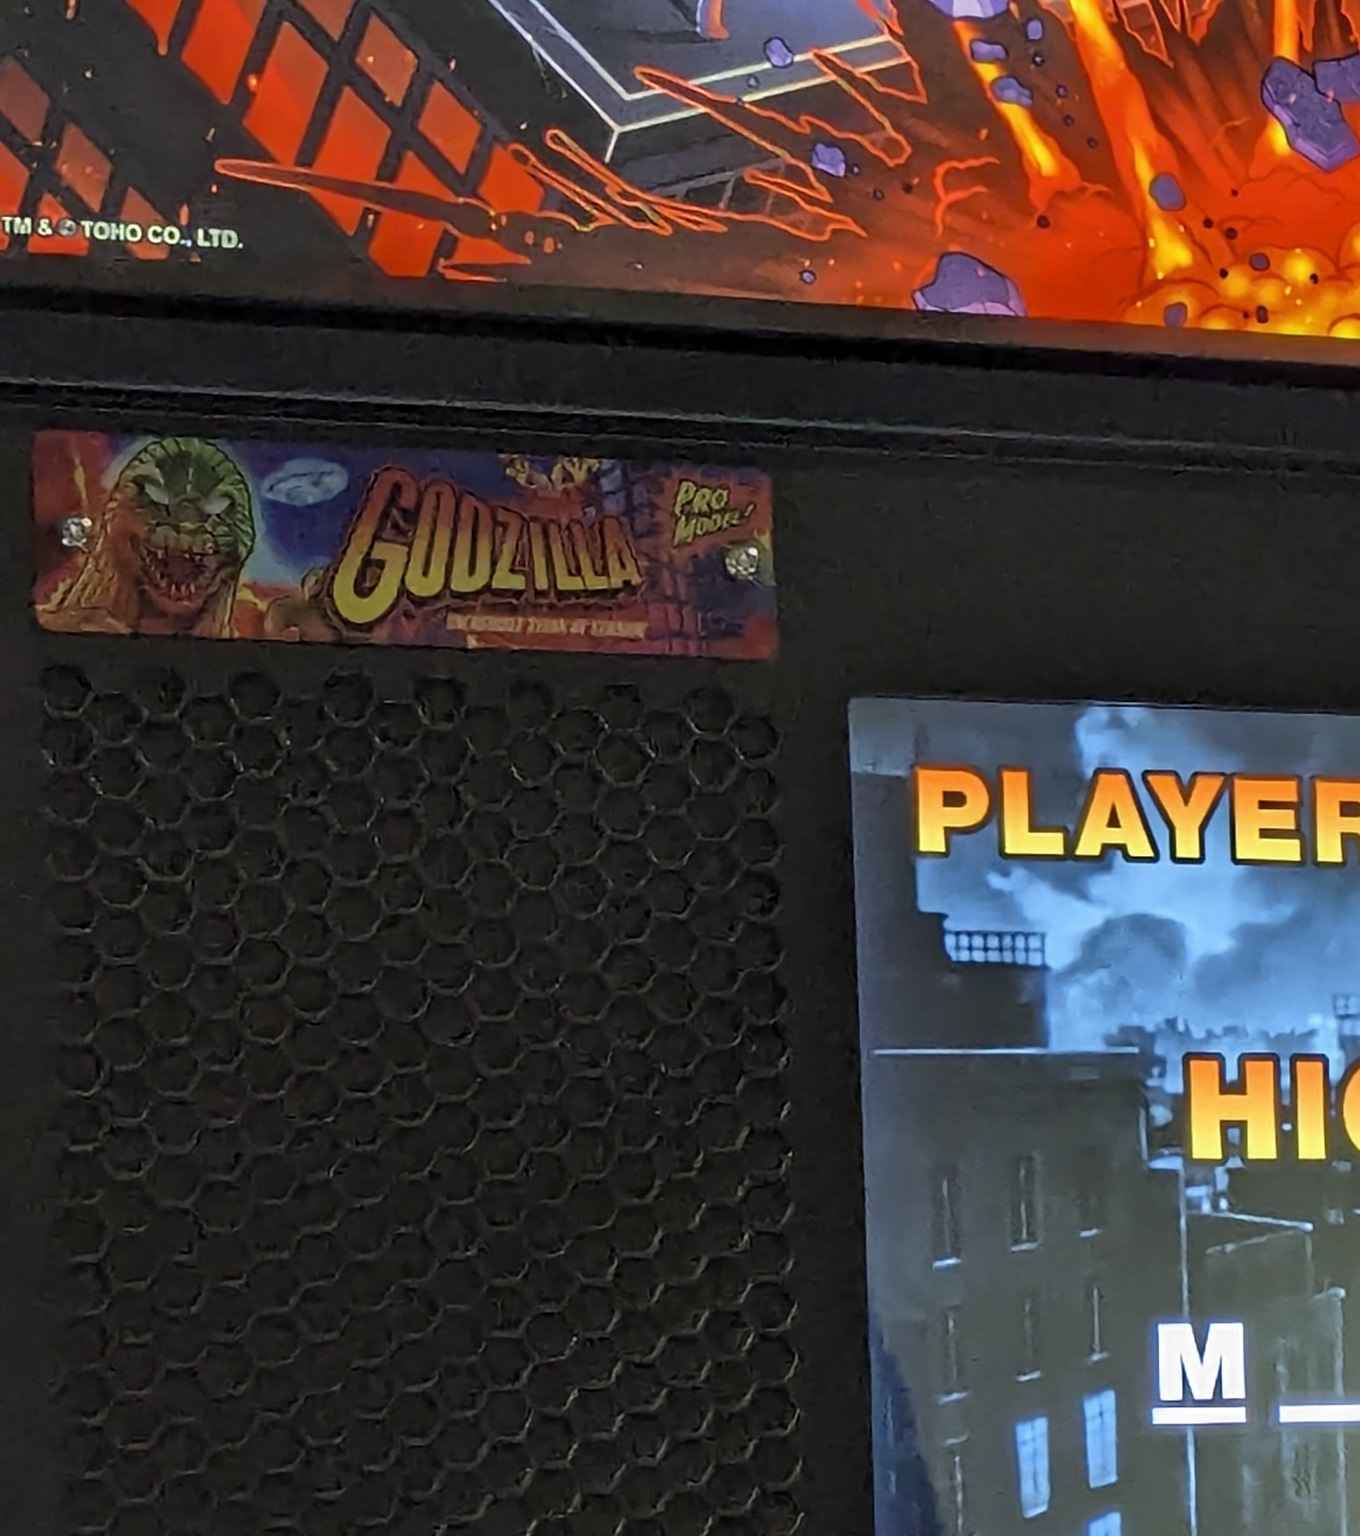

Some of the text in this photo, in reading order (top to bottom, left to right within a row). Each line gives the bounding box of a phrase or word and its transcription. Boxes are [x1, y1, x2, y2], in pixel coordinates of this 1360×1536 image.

[1, 216, 32, 236] TM
[37, 219, 54, 236] &
[80, 220, 142, 242] TOHO
[147, 225, 193, 248] CO.,
[197, 228, 244, 250] LTD.
[674, 480, 729, 518] PRO
[333, 466, 645, 624] GODZILLA
[1158, 1322, 1246, 1401] M
